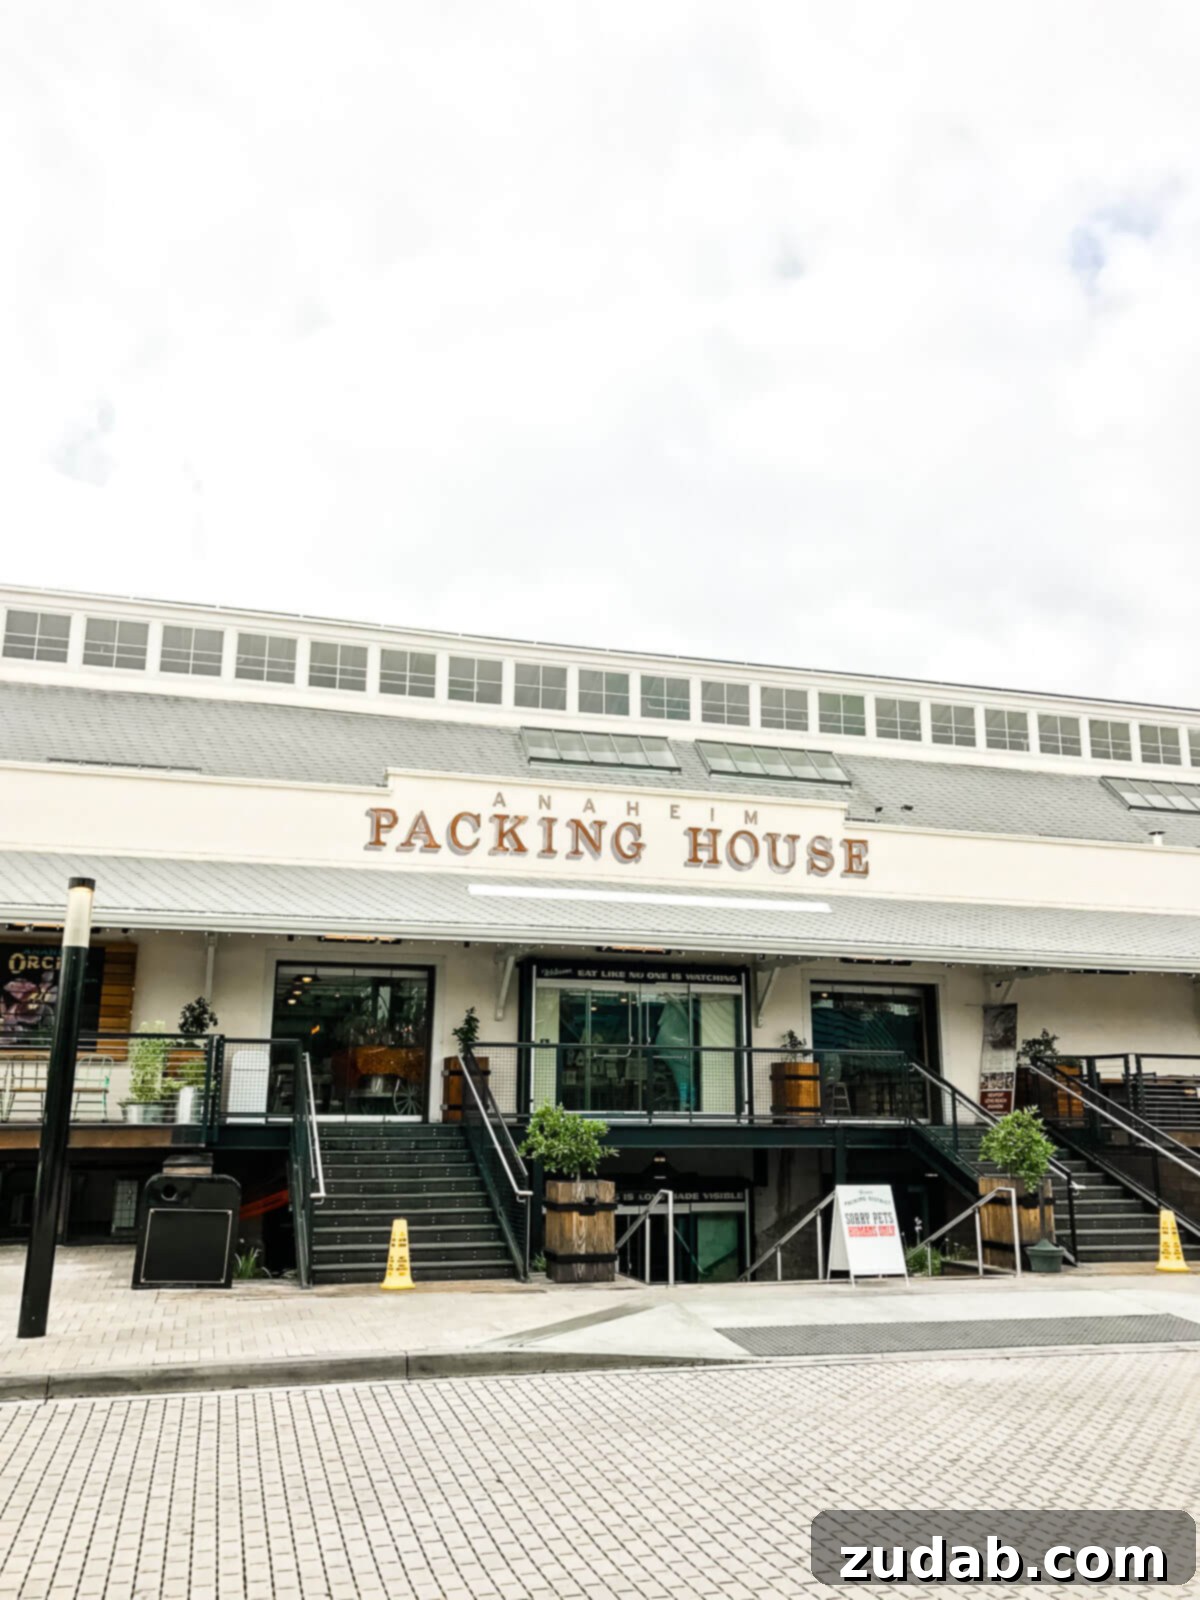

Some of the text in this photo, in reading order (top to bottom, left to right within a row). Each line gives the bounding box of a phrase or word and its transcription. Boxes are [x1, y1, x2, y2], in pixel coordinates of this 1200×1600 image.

[492, 791, 758, 825] ANAHEIM
[363, 807, 869, 878] PACKING HOUSE
[577, 969, 598, 977] EAT
[601, 970, 626, 978] LIKE
[628, 971, 644, 979] NO
[646, 972, 669, 980] ONE
[671, 972, 682, 980] IS
[685, 973, 738, 982] WATCHING
[623, 1192, 634, 1200] IS
[702, 1192, 744, 1200] VISIBLE
[845, 1212, 895, 1225] SORRY PETS
